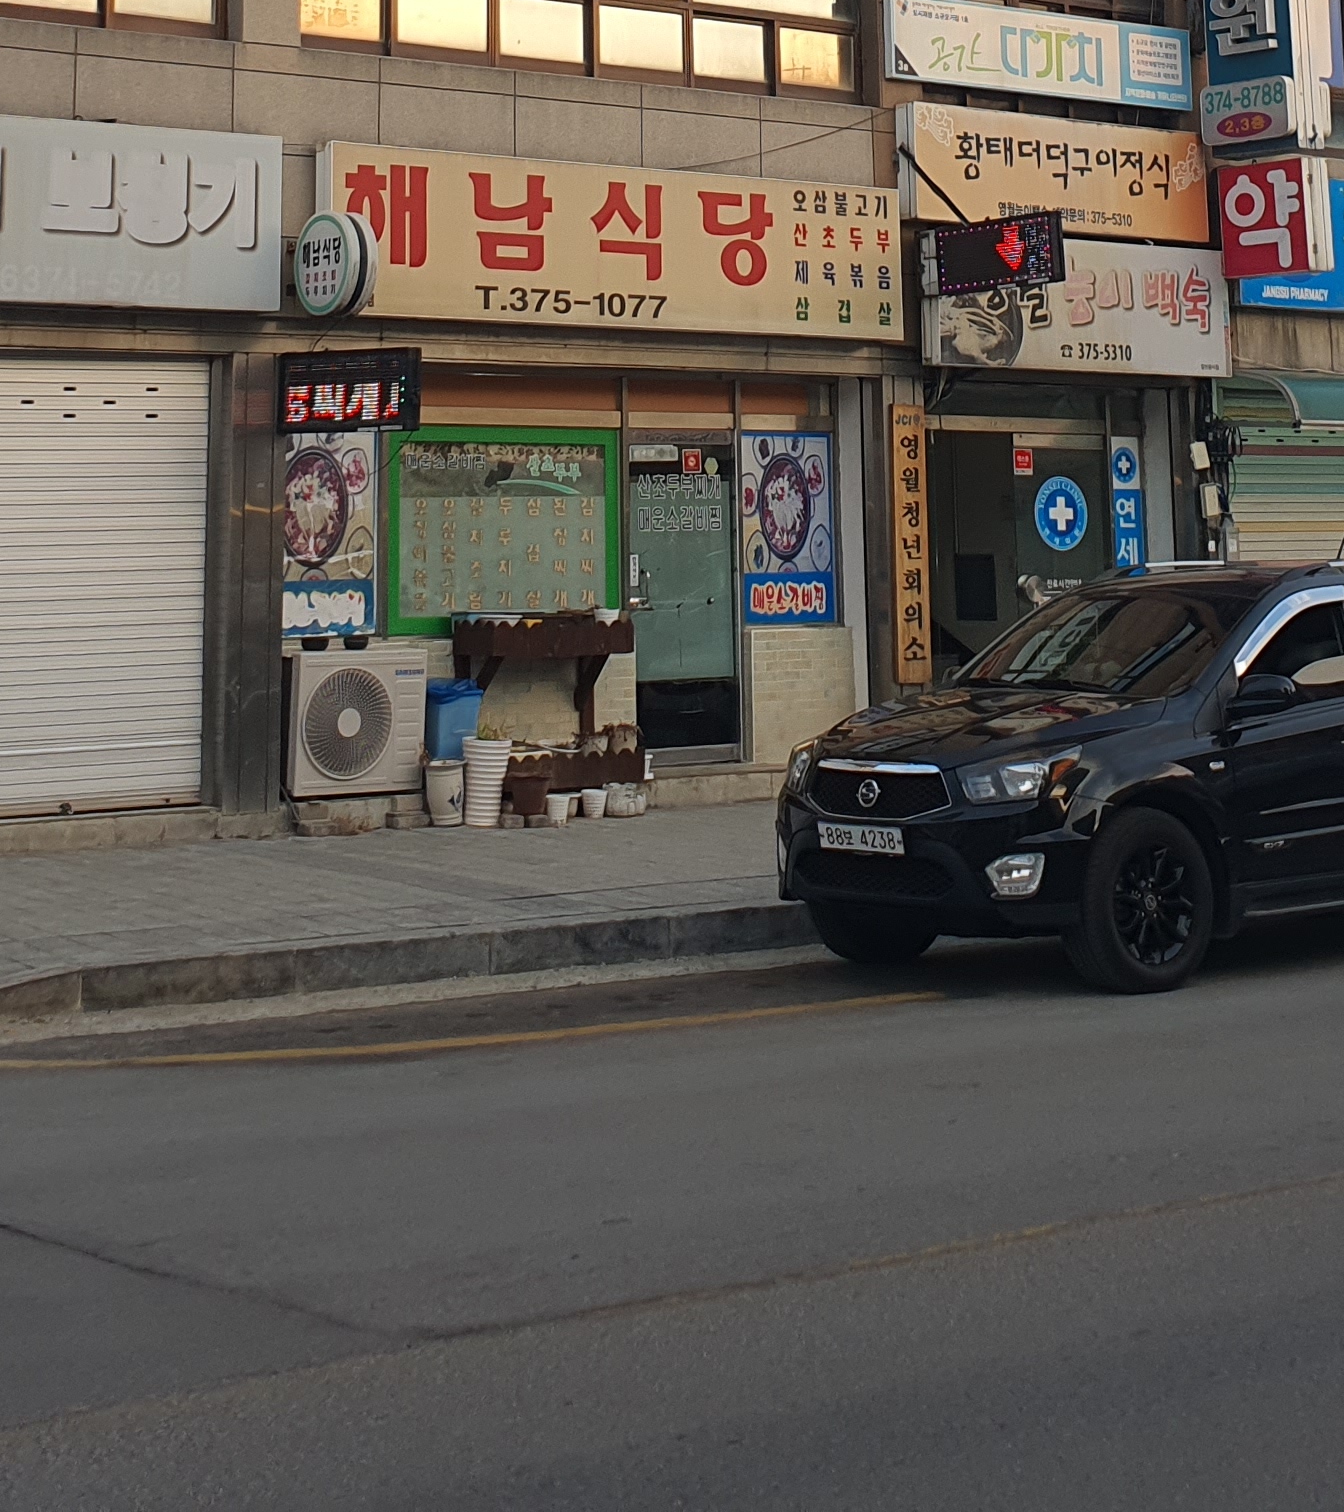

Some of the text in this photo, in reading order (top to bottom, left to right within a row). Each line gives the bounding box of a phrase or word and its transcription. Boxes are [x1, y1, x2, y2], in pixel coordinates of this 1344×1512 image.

[928, 32, 1002, 75] 공간
[1204, 80, 1286, 115] 374-8788
[955, 131, 1171, 200] 황태더덕구이정식
[793, 189, 888, 219] 오삼불고기
[1224, 168, 1300, 270] 약
[345, 164, 774, 287] 해남식당
[793, 223, 891, 254] 산초두부
[794, 260, 892, 290] 제육볶음
[475, 284, 669, 320] T.375-1077
[1062, 256, 1133, 325] 능이
[1142, 265, 1211, 333] 백숙
[1290, 286, 1329, 302] PHARMACY
[795, 296, 892, 327] 삼겹살
[1077, 343, 1132, 362] 375-5310
[894, 413, 913, 427] JCI
[405, 452, 488, 472] 매운소갈비찜
[636, 473, 722, 501] 산초두부찌개
[637, 504, 723, 532] 매운소갈비찜
[1115, 497, 1139, 566] 연세
[900, 434, 928, 663] 영월청년회의소
[750, 579, 826, 616] 매운소갈비찜
[824, 826, 896, 850] 88보 4238
